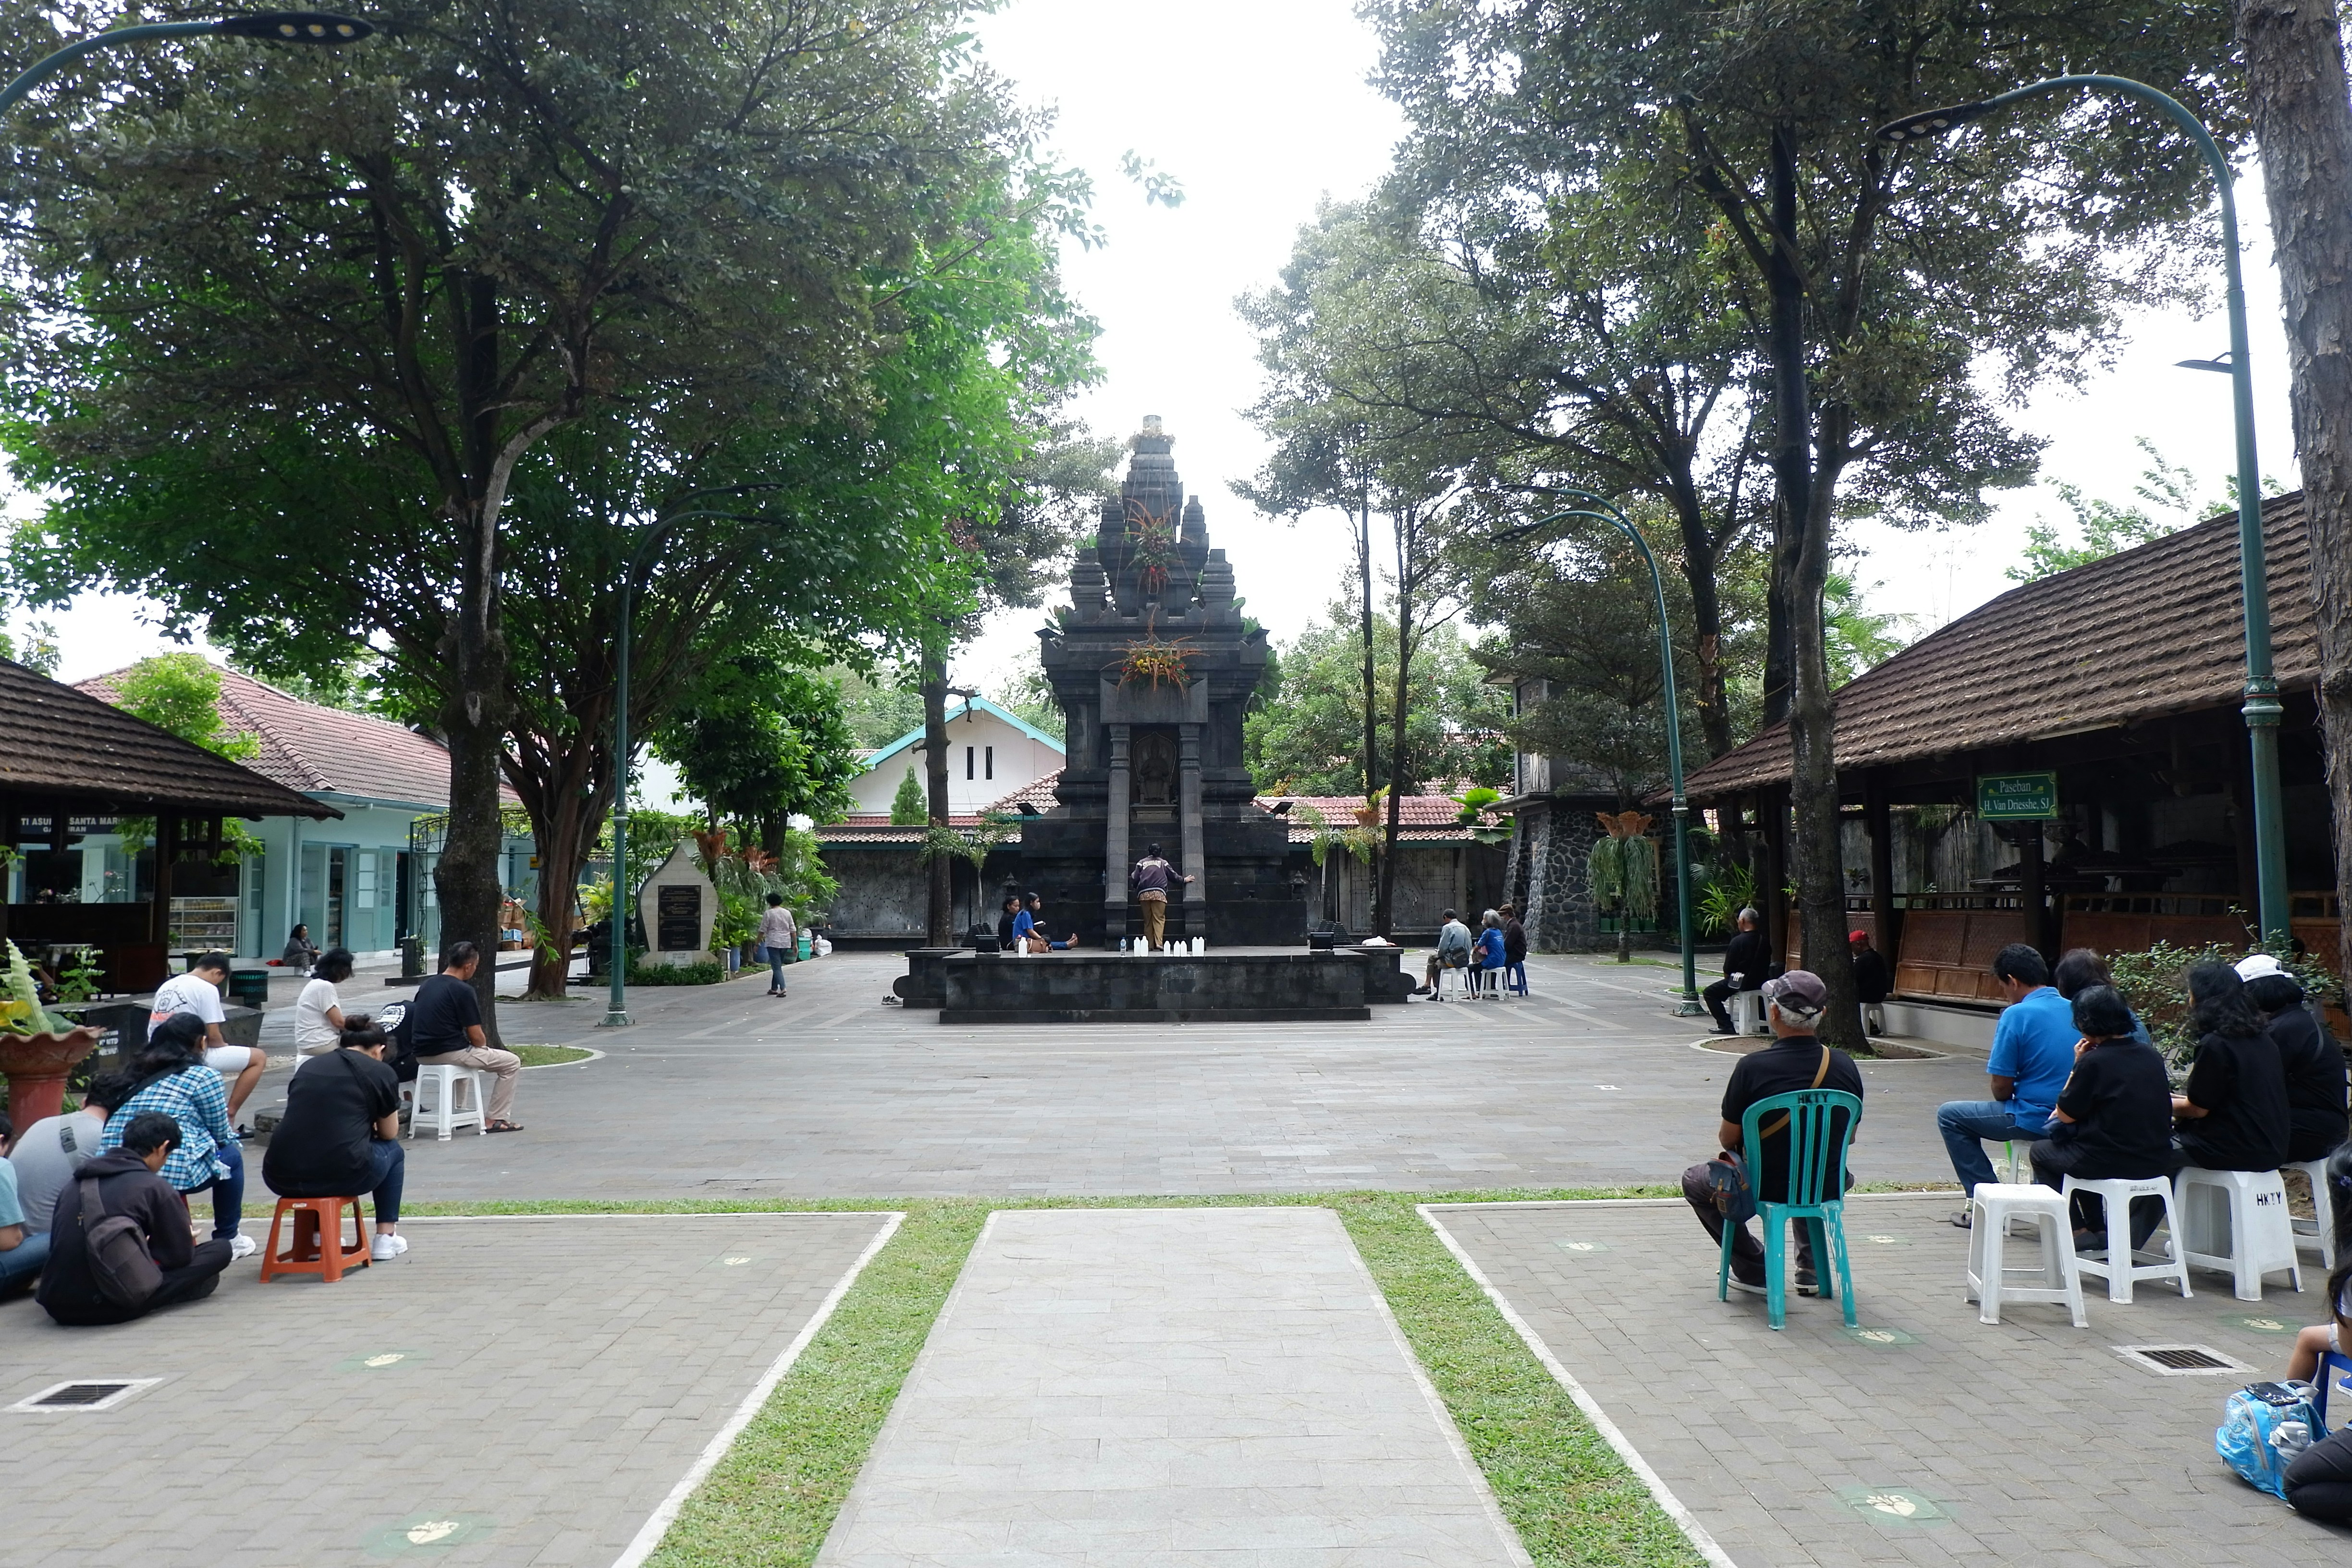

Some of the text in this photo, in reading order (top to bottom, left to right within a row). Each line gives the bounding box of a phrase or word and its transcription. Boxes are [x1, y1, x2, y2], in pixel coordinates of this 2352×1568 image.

[2000, 780, 2031, 793] Paseban
[1984, 800, 1992, 811] H.
[1994, 799, 2006, 810] Van
[2041, 797, 2049, 809] SJ
[21, 817, 29, 825] TI
[69, 817, 96, 825] SANTA
[99, 817, 118, 825] MAR
[1798, 1092, 1829, 1104] HKTY
[2256, 1191, 2280, 1206] HKTY
